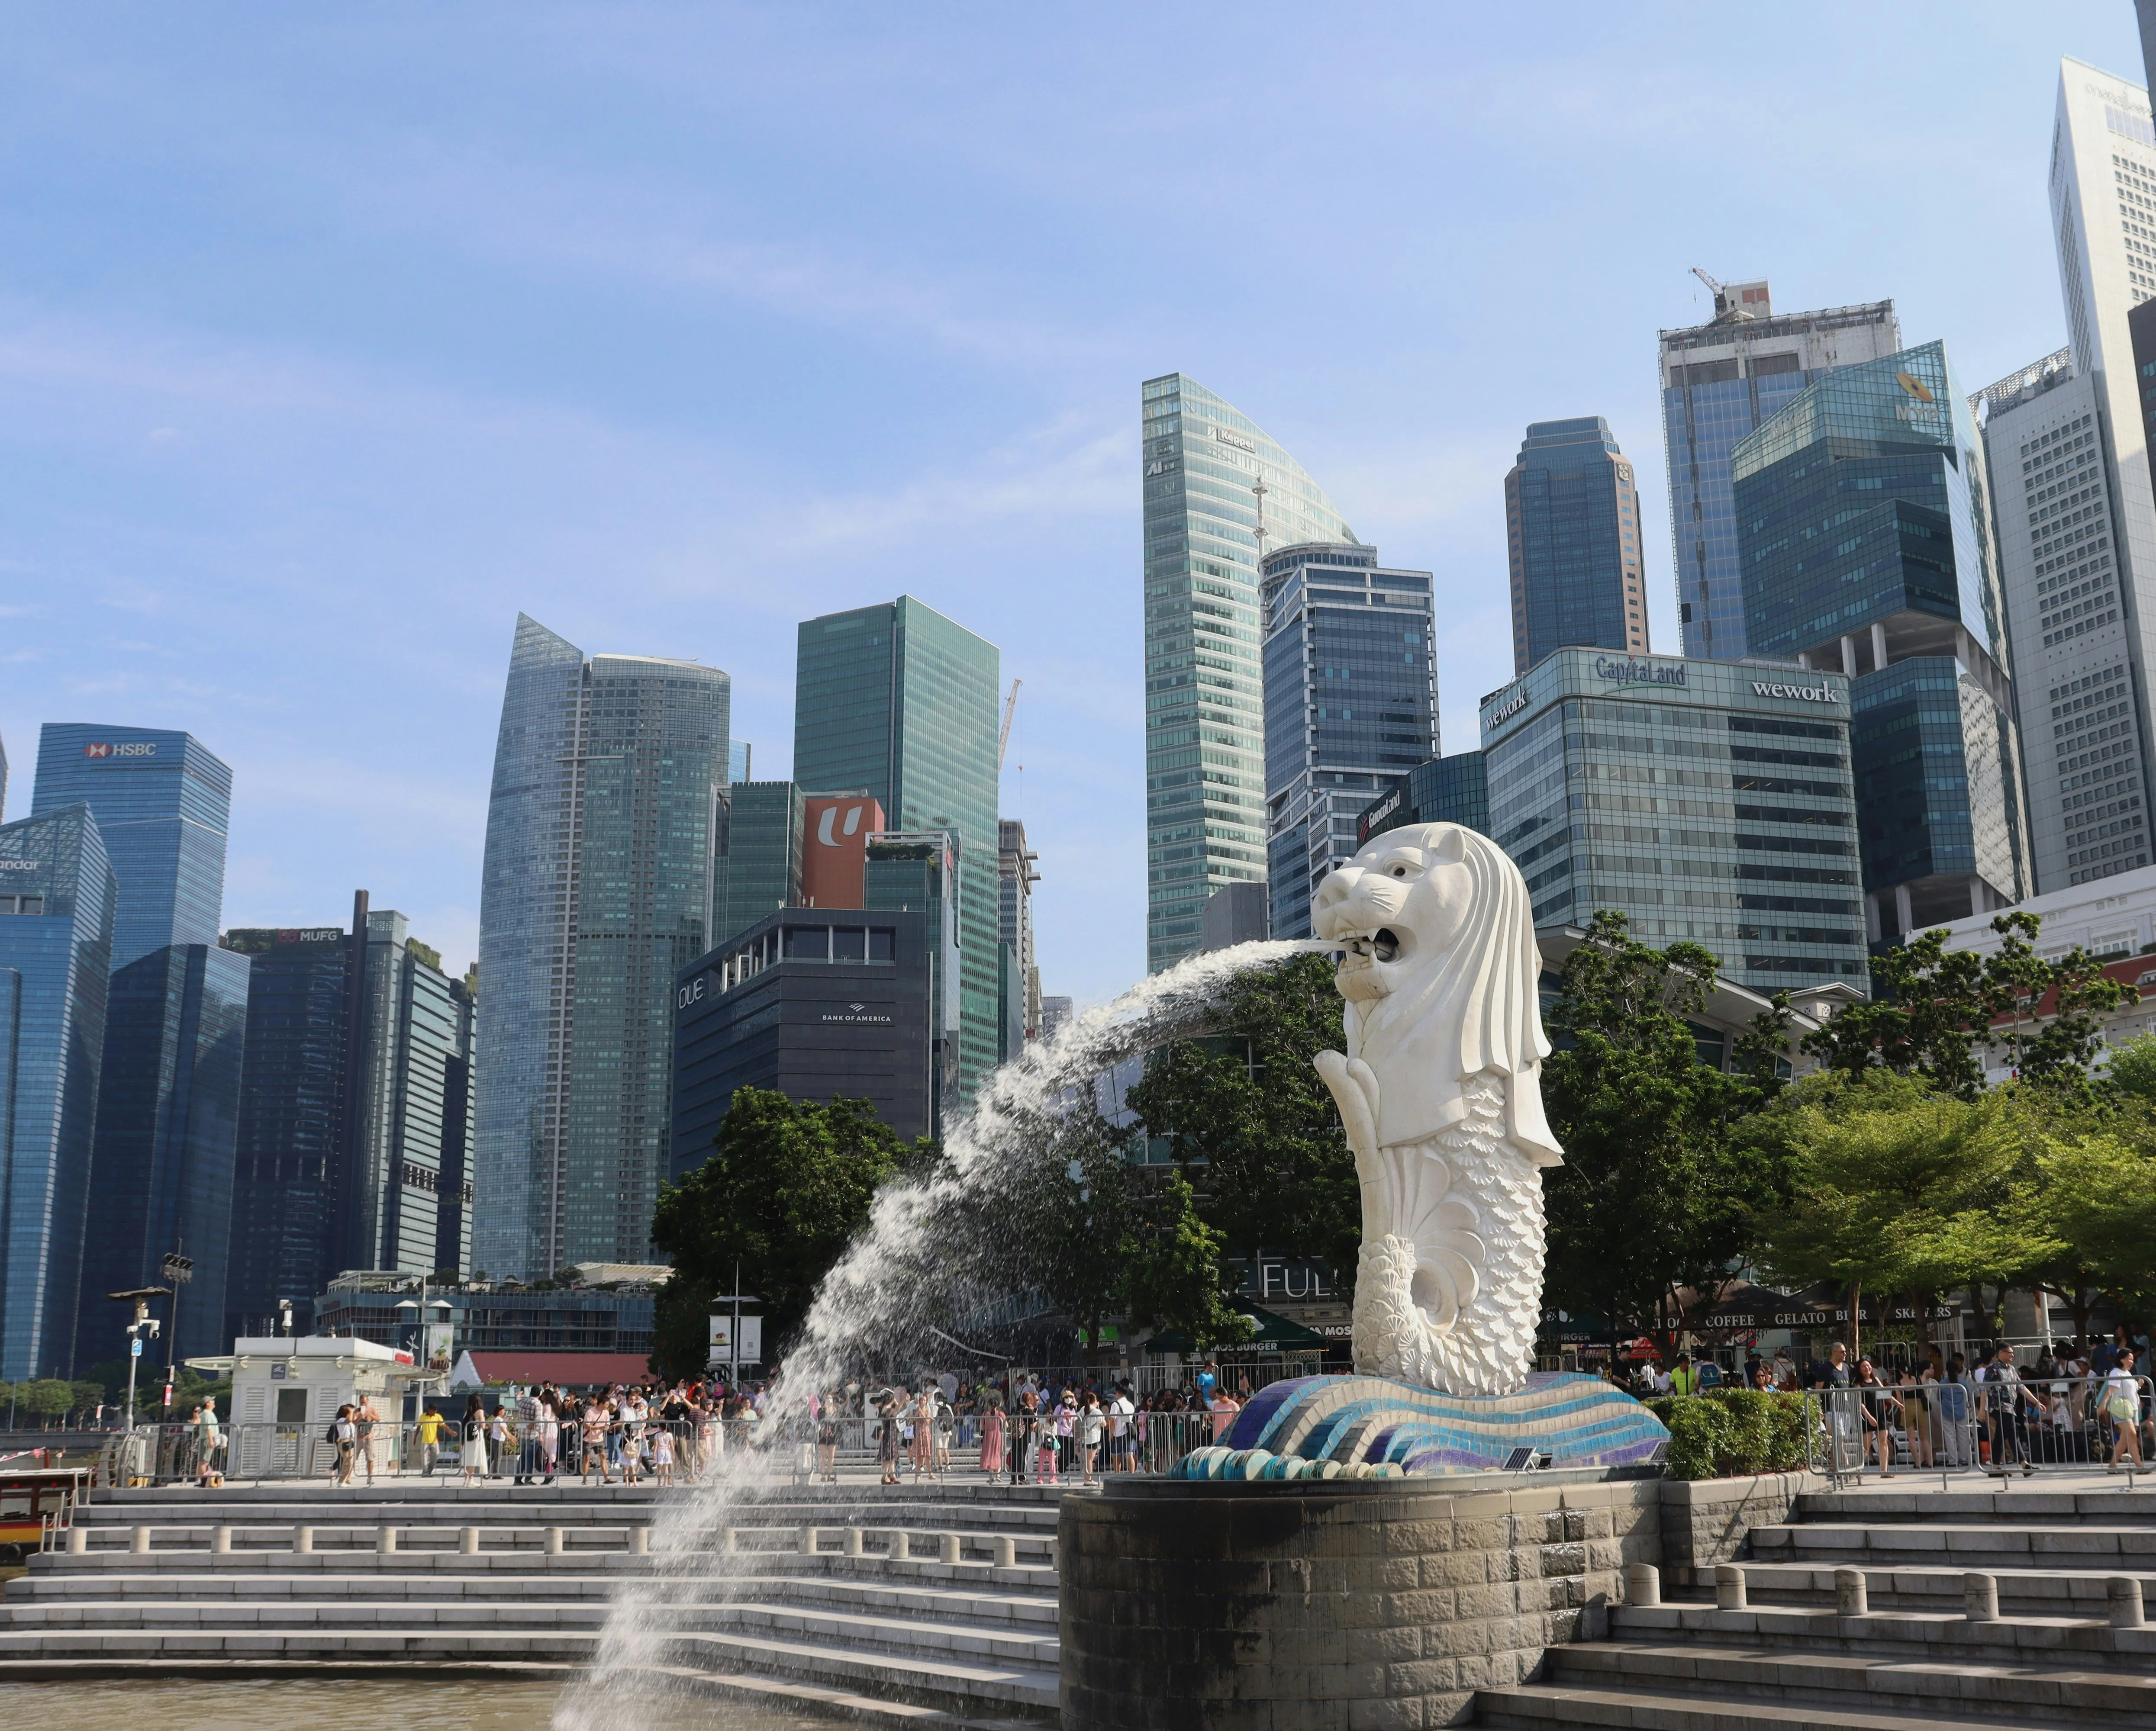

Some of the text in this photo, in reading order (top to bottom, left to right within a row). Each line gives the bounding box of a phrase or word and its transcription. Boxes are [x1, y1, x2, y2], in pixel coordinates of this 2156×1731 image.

[1895, 405, 1939, 422] MYP
[1221, 429, 1254, 449] Keppel
[1596, 655, 1685, 685] CapitaLand
[1751, 680, 1839, 703] wework
[1485, 685, 1526, 730] wework
[113, 743, 157, 756] HSBC
[1369, 790, 1400, 828] GuocoLand
[300, 931, 337, 941] MUFG
[679, 978, 704, 1009] OUE
[1705, 1315, 1755, 1327] COFFEE
[1775, 1313, 1826, 1325] GELATO
[1836, 1310, 1867, 1320] BER
[1325, 1326, 1351, 1336] MOS
